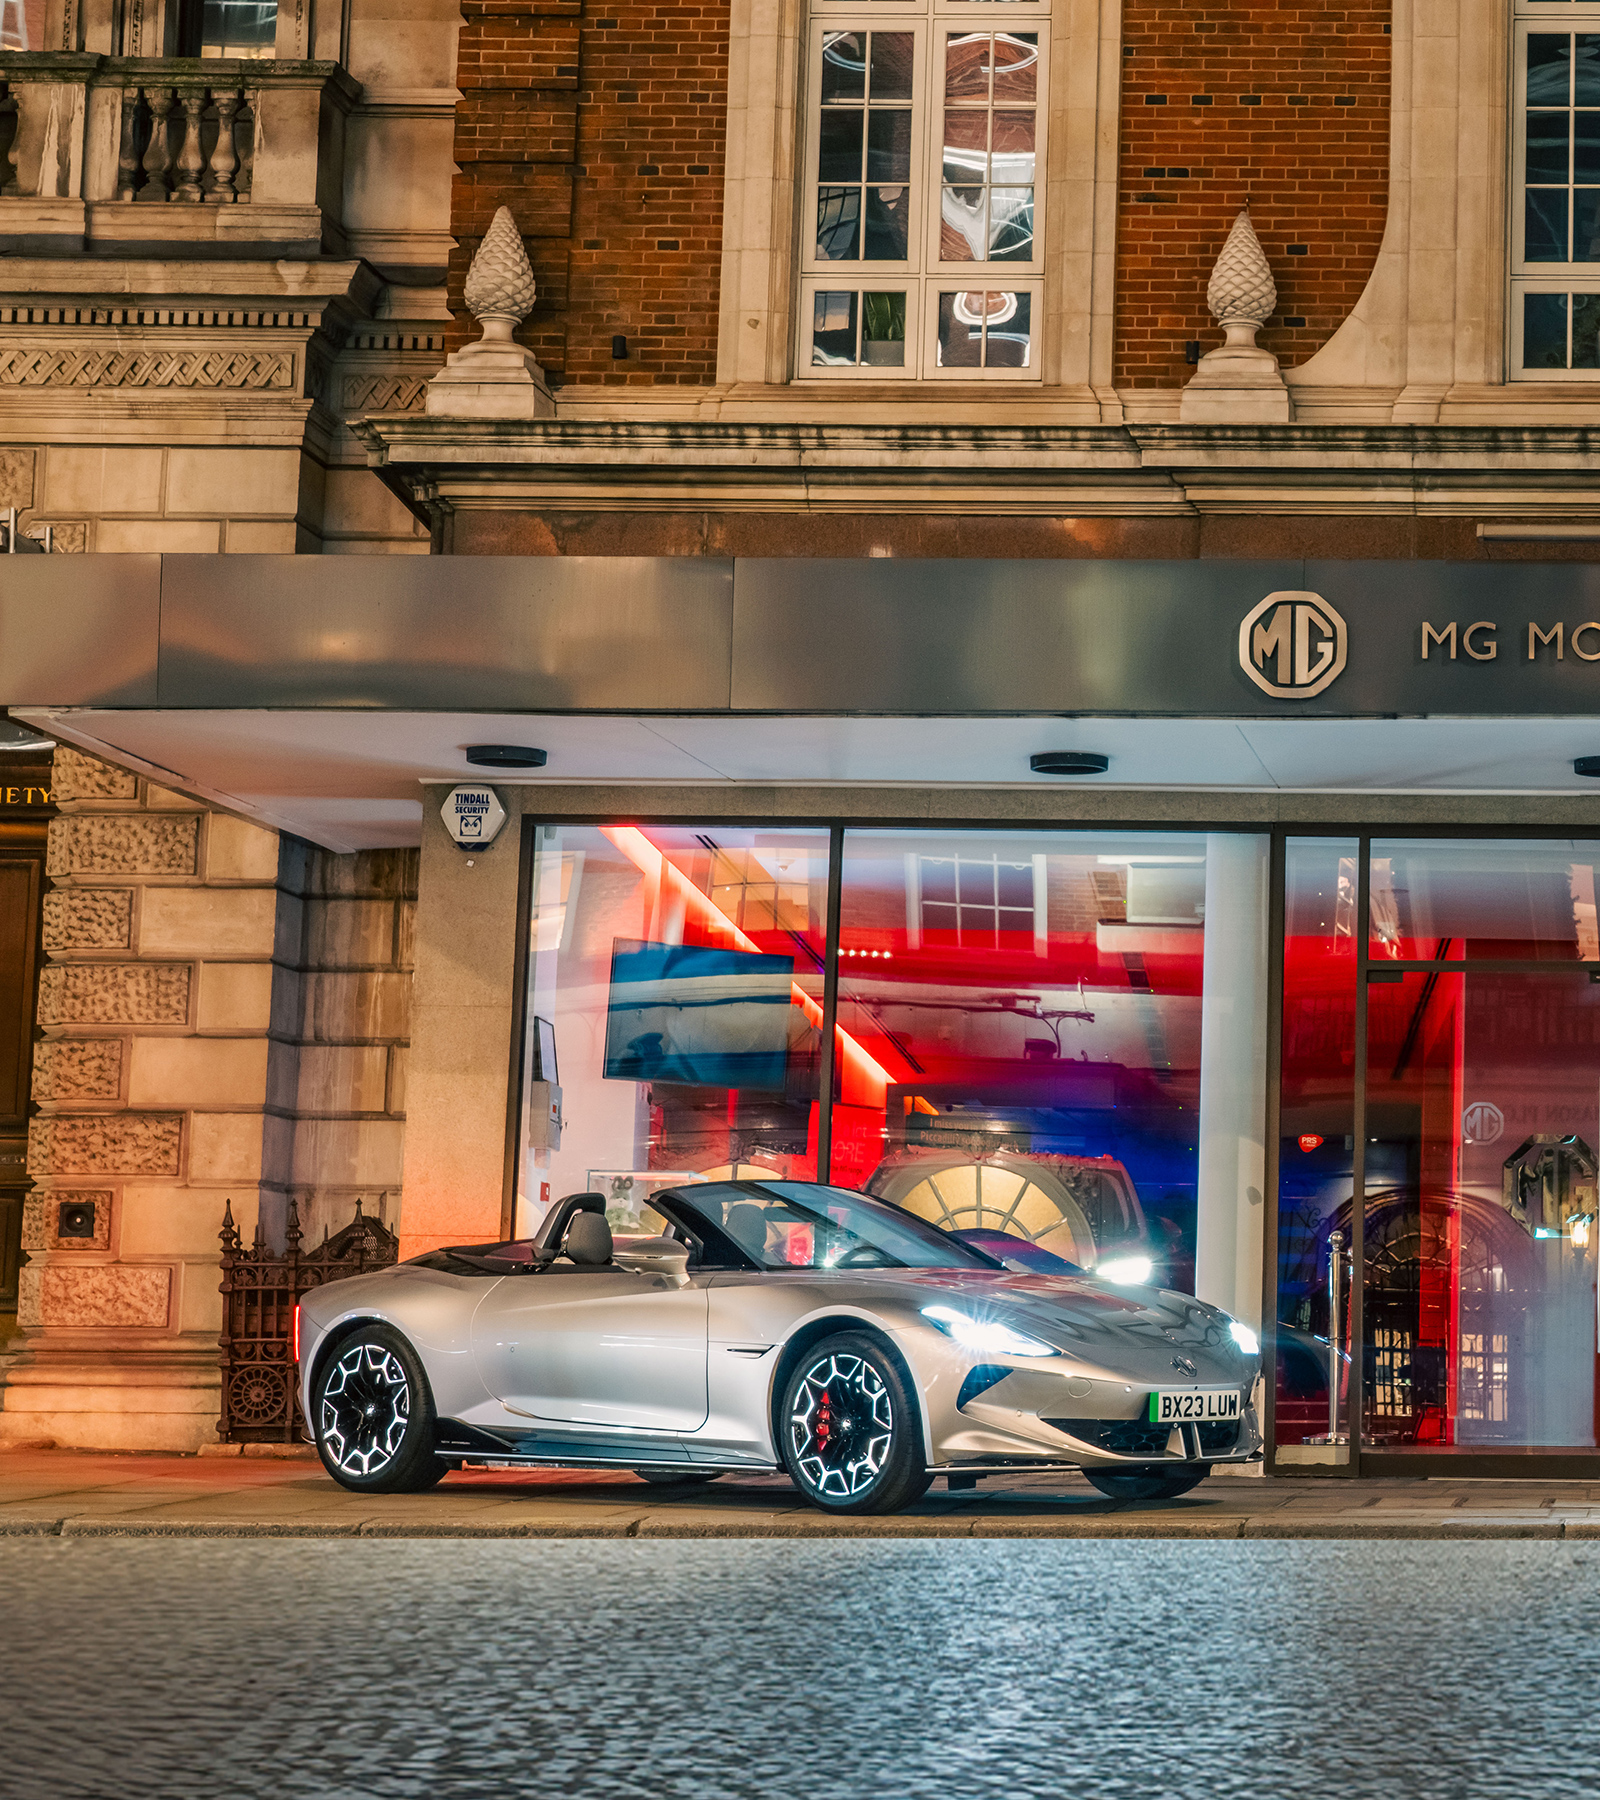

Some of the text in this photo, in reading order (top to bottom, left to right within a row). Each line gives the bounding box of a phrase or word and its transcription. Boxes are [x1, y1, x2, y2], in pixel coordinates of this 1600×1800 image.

[1248, 605, 1338, 688] MG
[1421, 621, 1498, 661] MG
[455, 793, 490, 804] TINDALL
[455, 806, 490, 814] SECURITY
[1464, 1105, 1501, 1142] MG
[1301, 1136, 1317, 1144] PRS
[832, 1141, 866, 1163] ORE
[1162, 1394, 1238, 1419] BX23 LUW
